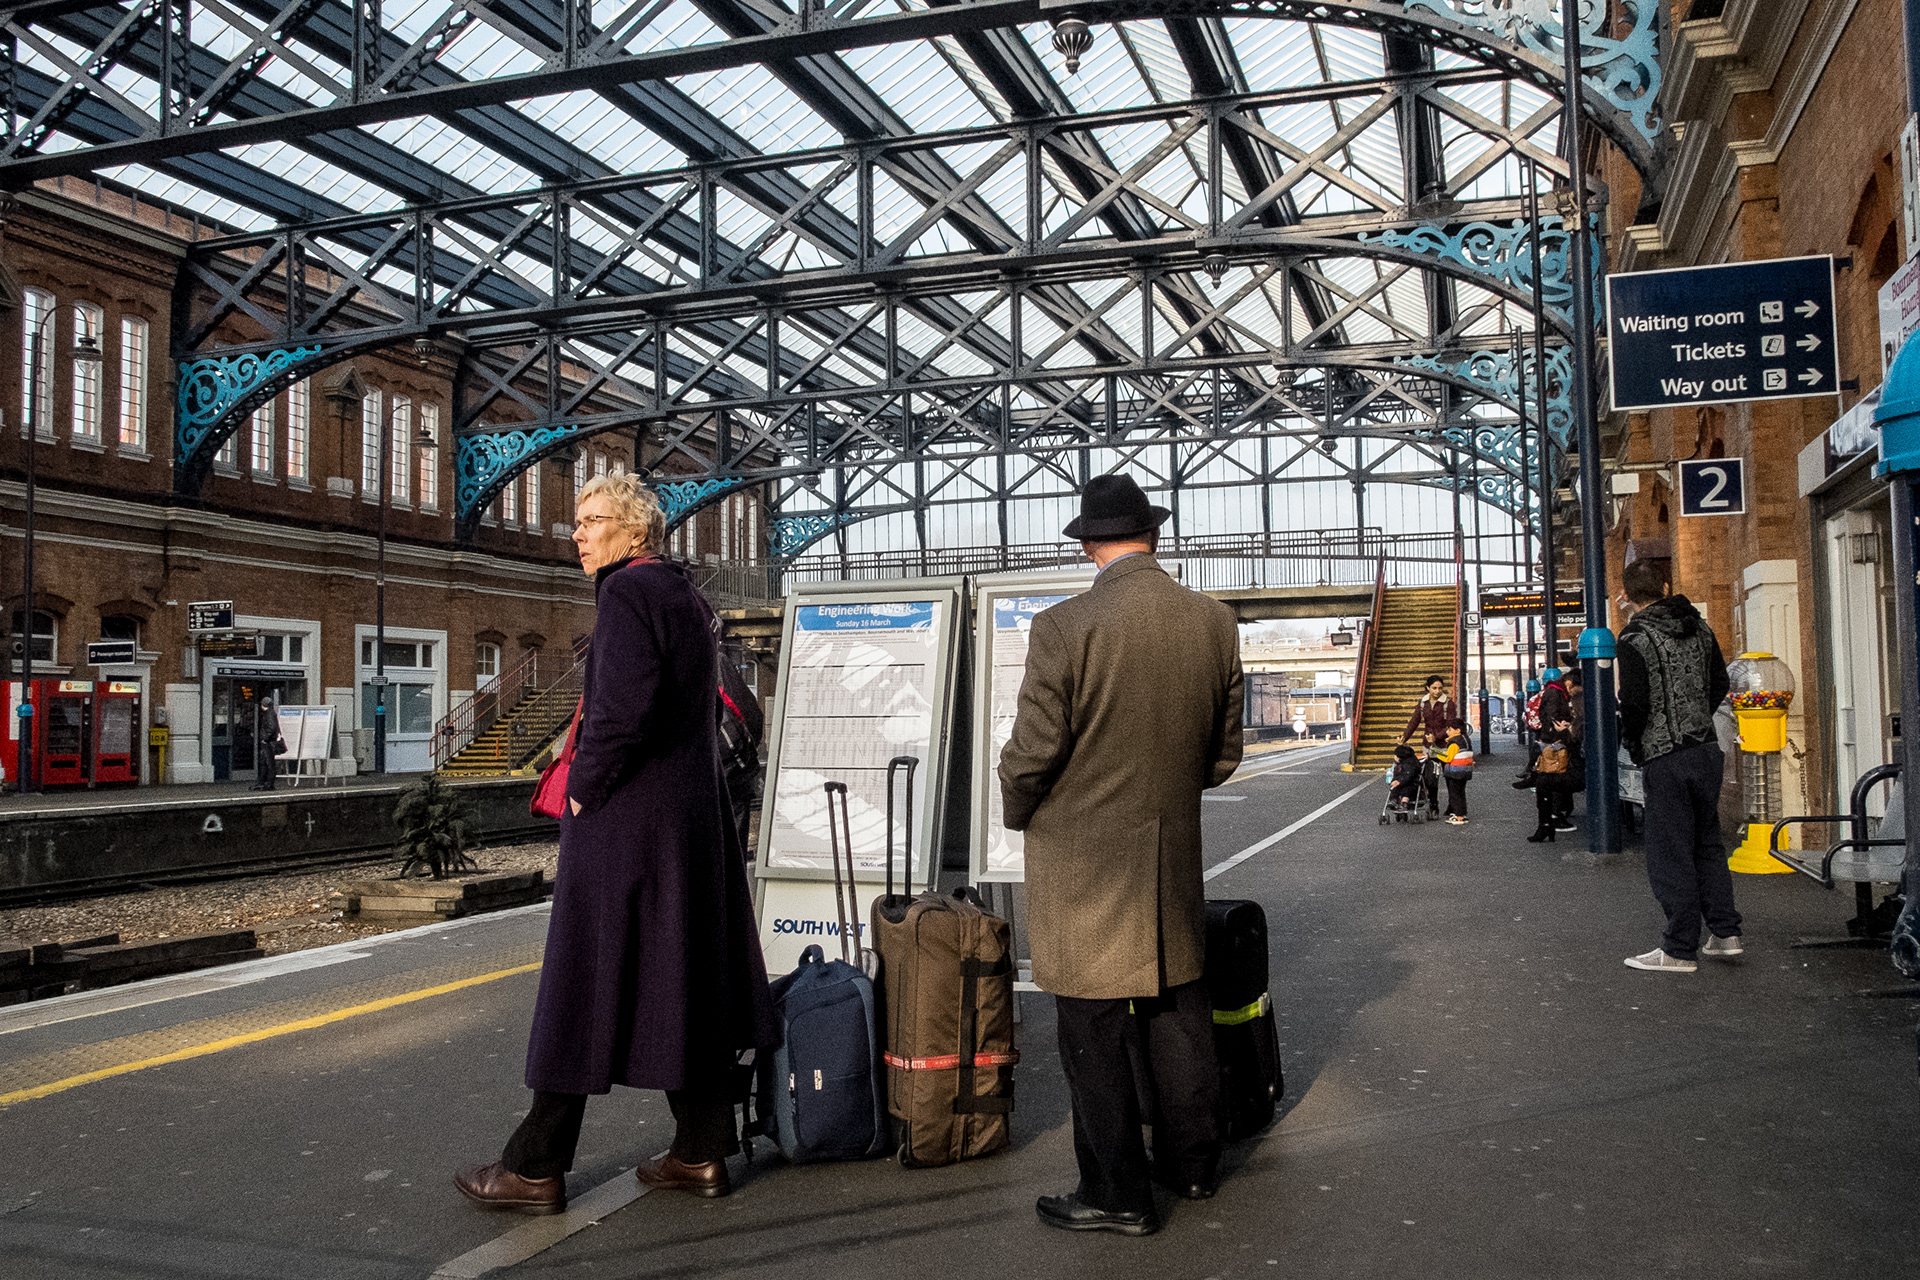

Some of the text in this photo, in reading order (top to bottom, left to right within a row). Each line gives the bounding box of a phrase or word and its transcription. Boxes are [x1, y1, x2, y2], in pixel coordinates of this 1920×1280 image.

[1619, 311, 1744, 333] Waiting room
[1671, 341, 1746, 361] Tickets
[1660, 374, 1747, 398] Way out
[1698, 466, 1729, 508] 2
[818, 603, 912, 617] Engineering Work
[836, 619, 891, 628] Sunday 16 March
[1557, 615, 1574, 624] Help
[773, 918, 823, 935] SOUTH
